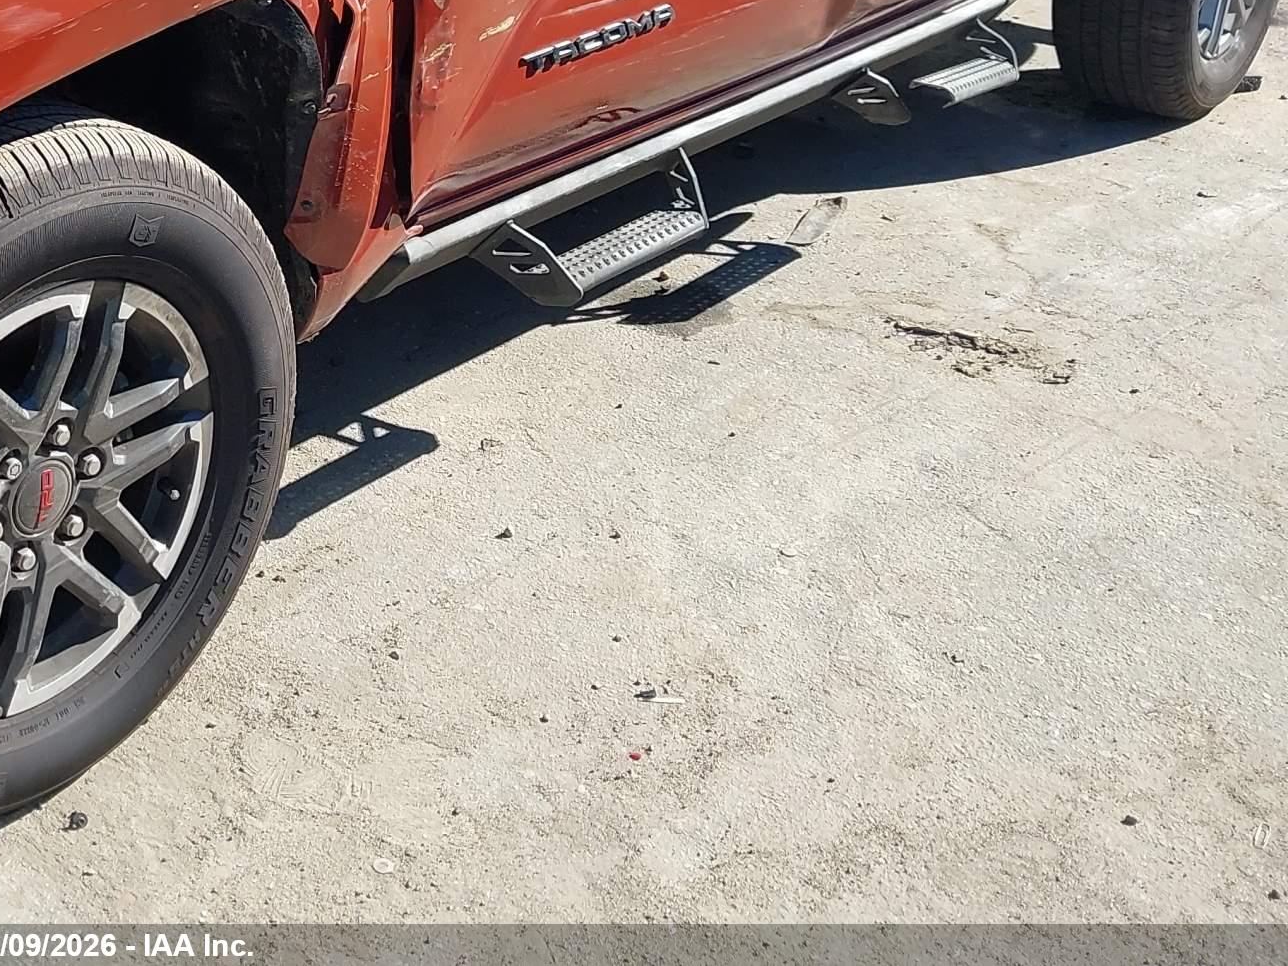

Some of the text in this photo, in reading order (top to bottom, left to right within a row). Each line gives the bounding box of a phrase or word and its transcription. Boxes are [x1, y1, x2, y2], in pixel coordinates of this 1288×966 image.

[518, 3, 674, 78] TACOMA
[36, 468, 55, 528] TRD
[196, 387, 277, 629] GRABBER
